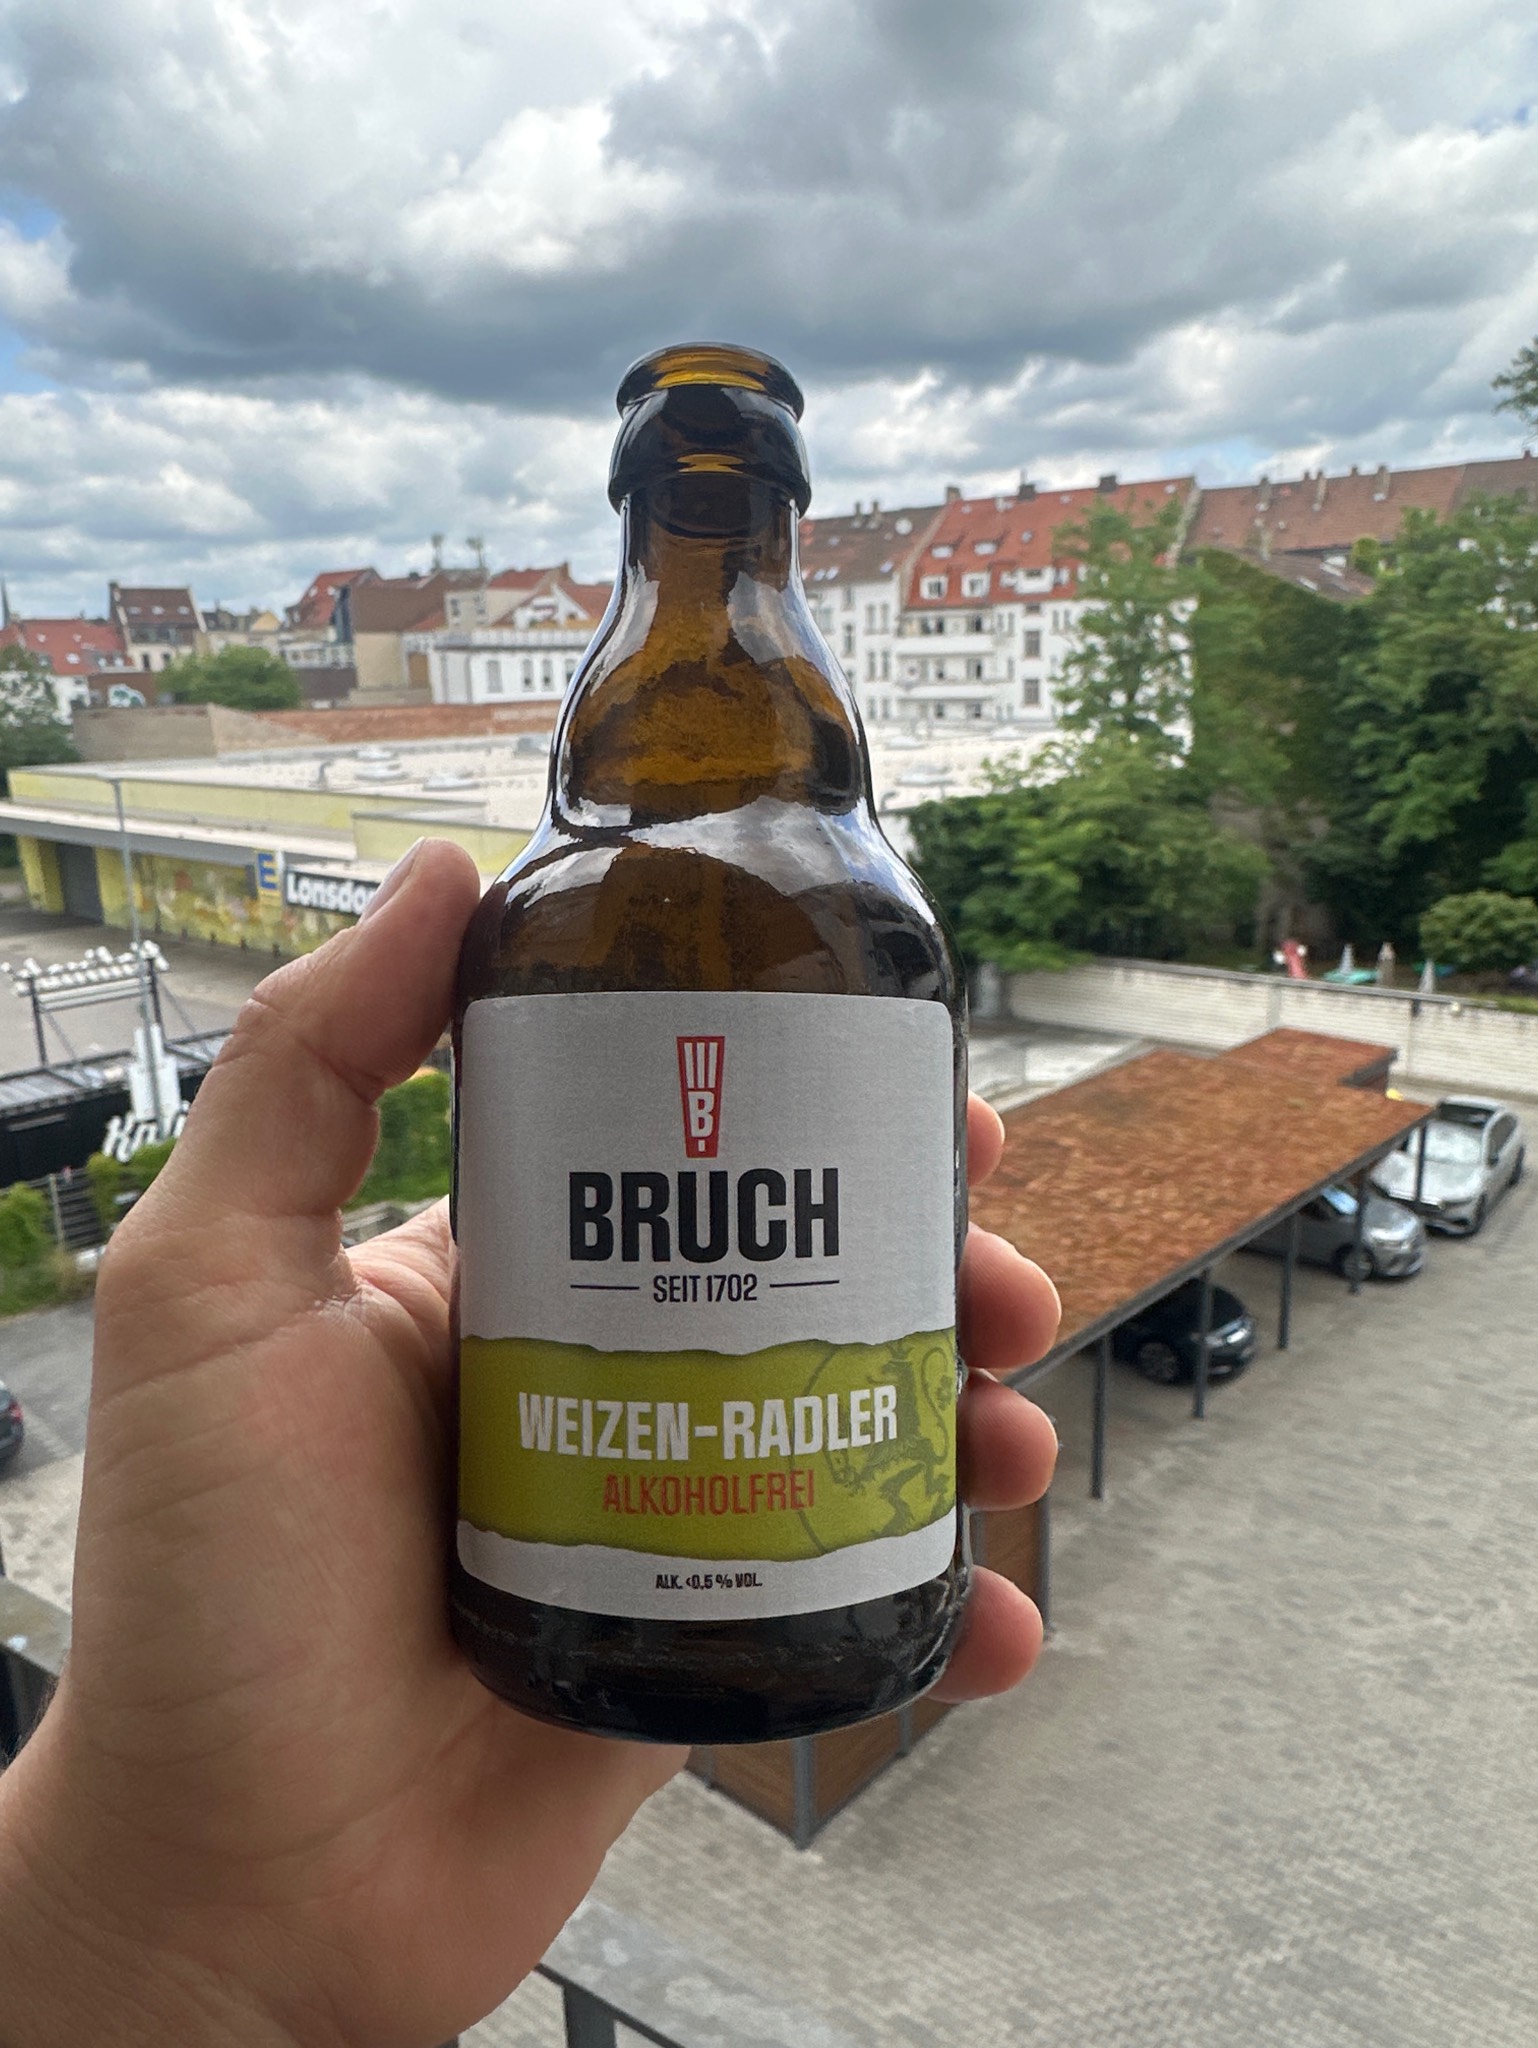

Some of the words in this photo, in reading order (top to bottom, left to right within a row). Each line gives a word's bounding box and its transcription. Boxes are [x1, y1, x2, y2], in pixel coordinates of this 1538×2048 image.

[258, 852, 277, 889] E
[569, 1168, 839, 1263] BRUCH
[653, 1275, 700, 1302] SEIT
[706, 1273, 757, 1302] 1702
[519, 1385, 897, 1461] WEIZEN-RADLER
[603, 1469, 815, 1516] ALKOHOLFREI
[656, 1574, 682, 1589] ALK.
[715, 1573, 733, 1588] %
[735, 1572, 762, 1588] VOL.
